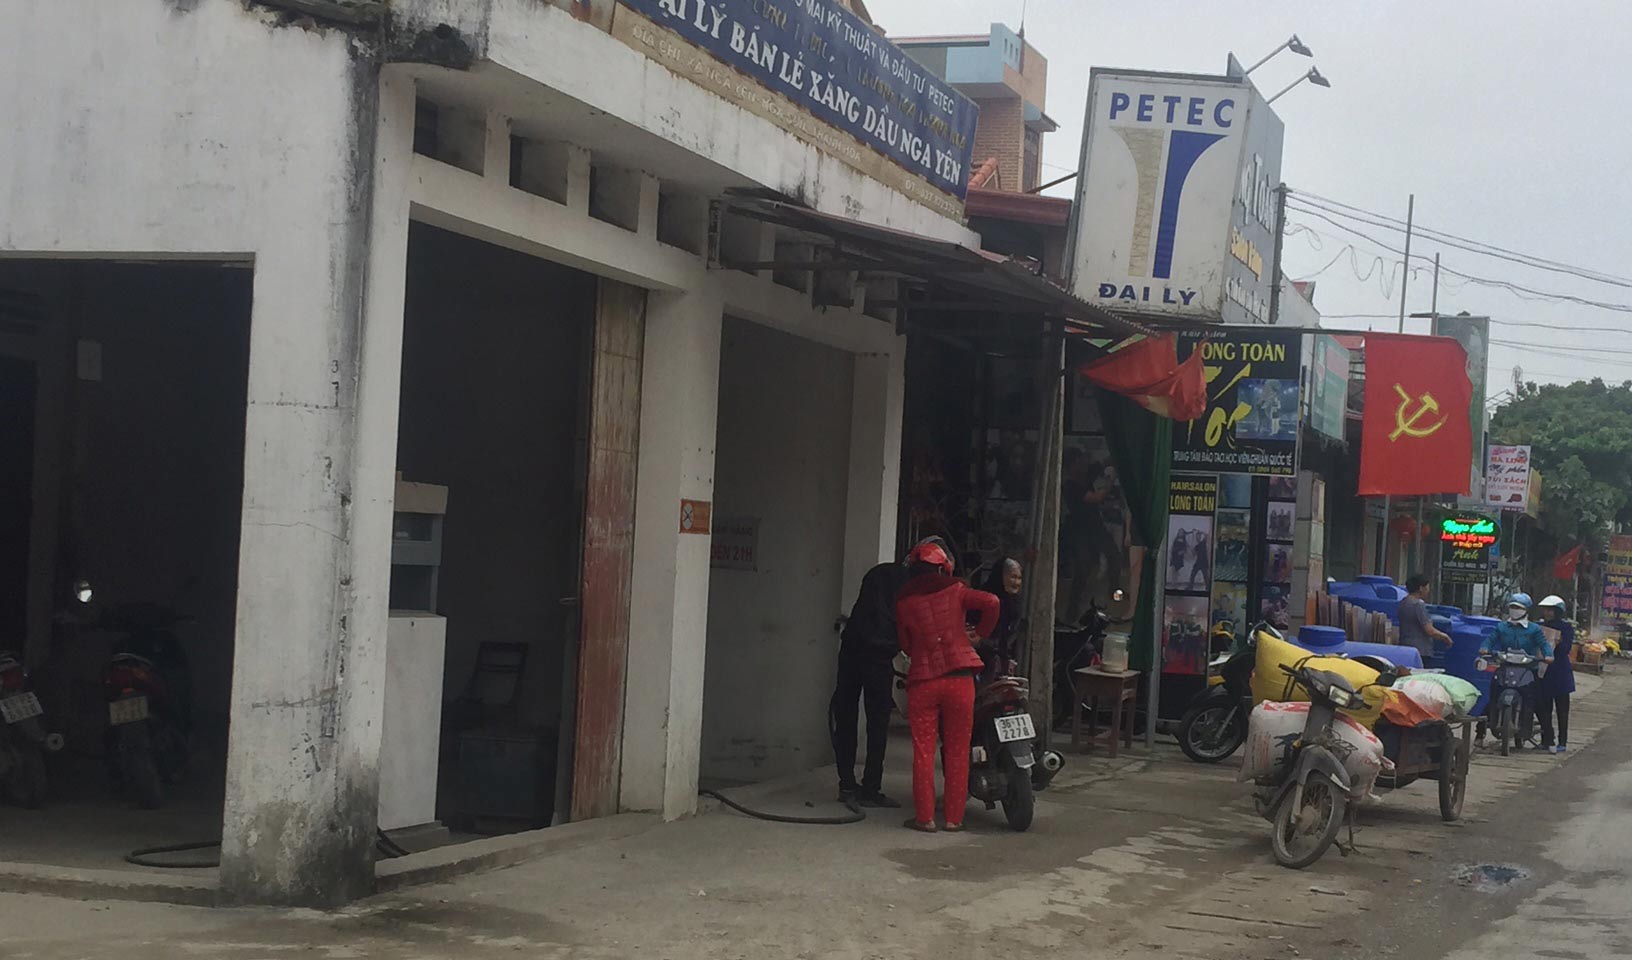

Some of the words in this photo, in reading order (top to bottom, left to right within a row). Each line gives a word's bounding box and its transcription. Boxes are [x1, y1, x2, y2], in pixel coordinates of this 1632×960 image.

[844, 22, 877, 60] THUẬT
[879, 47, 890, 70] VÀ
[912, 73, 926, 94] TƯ
[927, 84, 954, 115] PETEC
[693, 0, 728, 39] LÝ
[808, 71, 860, 123] XĂNG
[862, 104, 899, 147] DẦU
[900, 128, 931, 169] NGA
[935, 150, 962, 186] YÊN
[1108, 91, 1236, 129] PETEC
[1098, 282, 1151, 304] ĐẠI
[1162, 286, 1198, 306] LÝ
[1239, 339, 1286, 362] TOÀN
[1169, 495, 1191, 510] LONG
[1002, 726, 1030, 740] 2278
